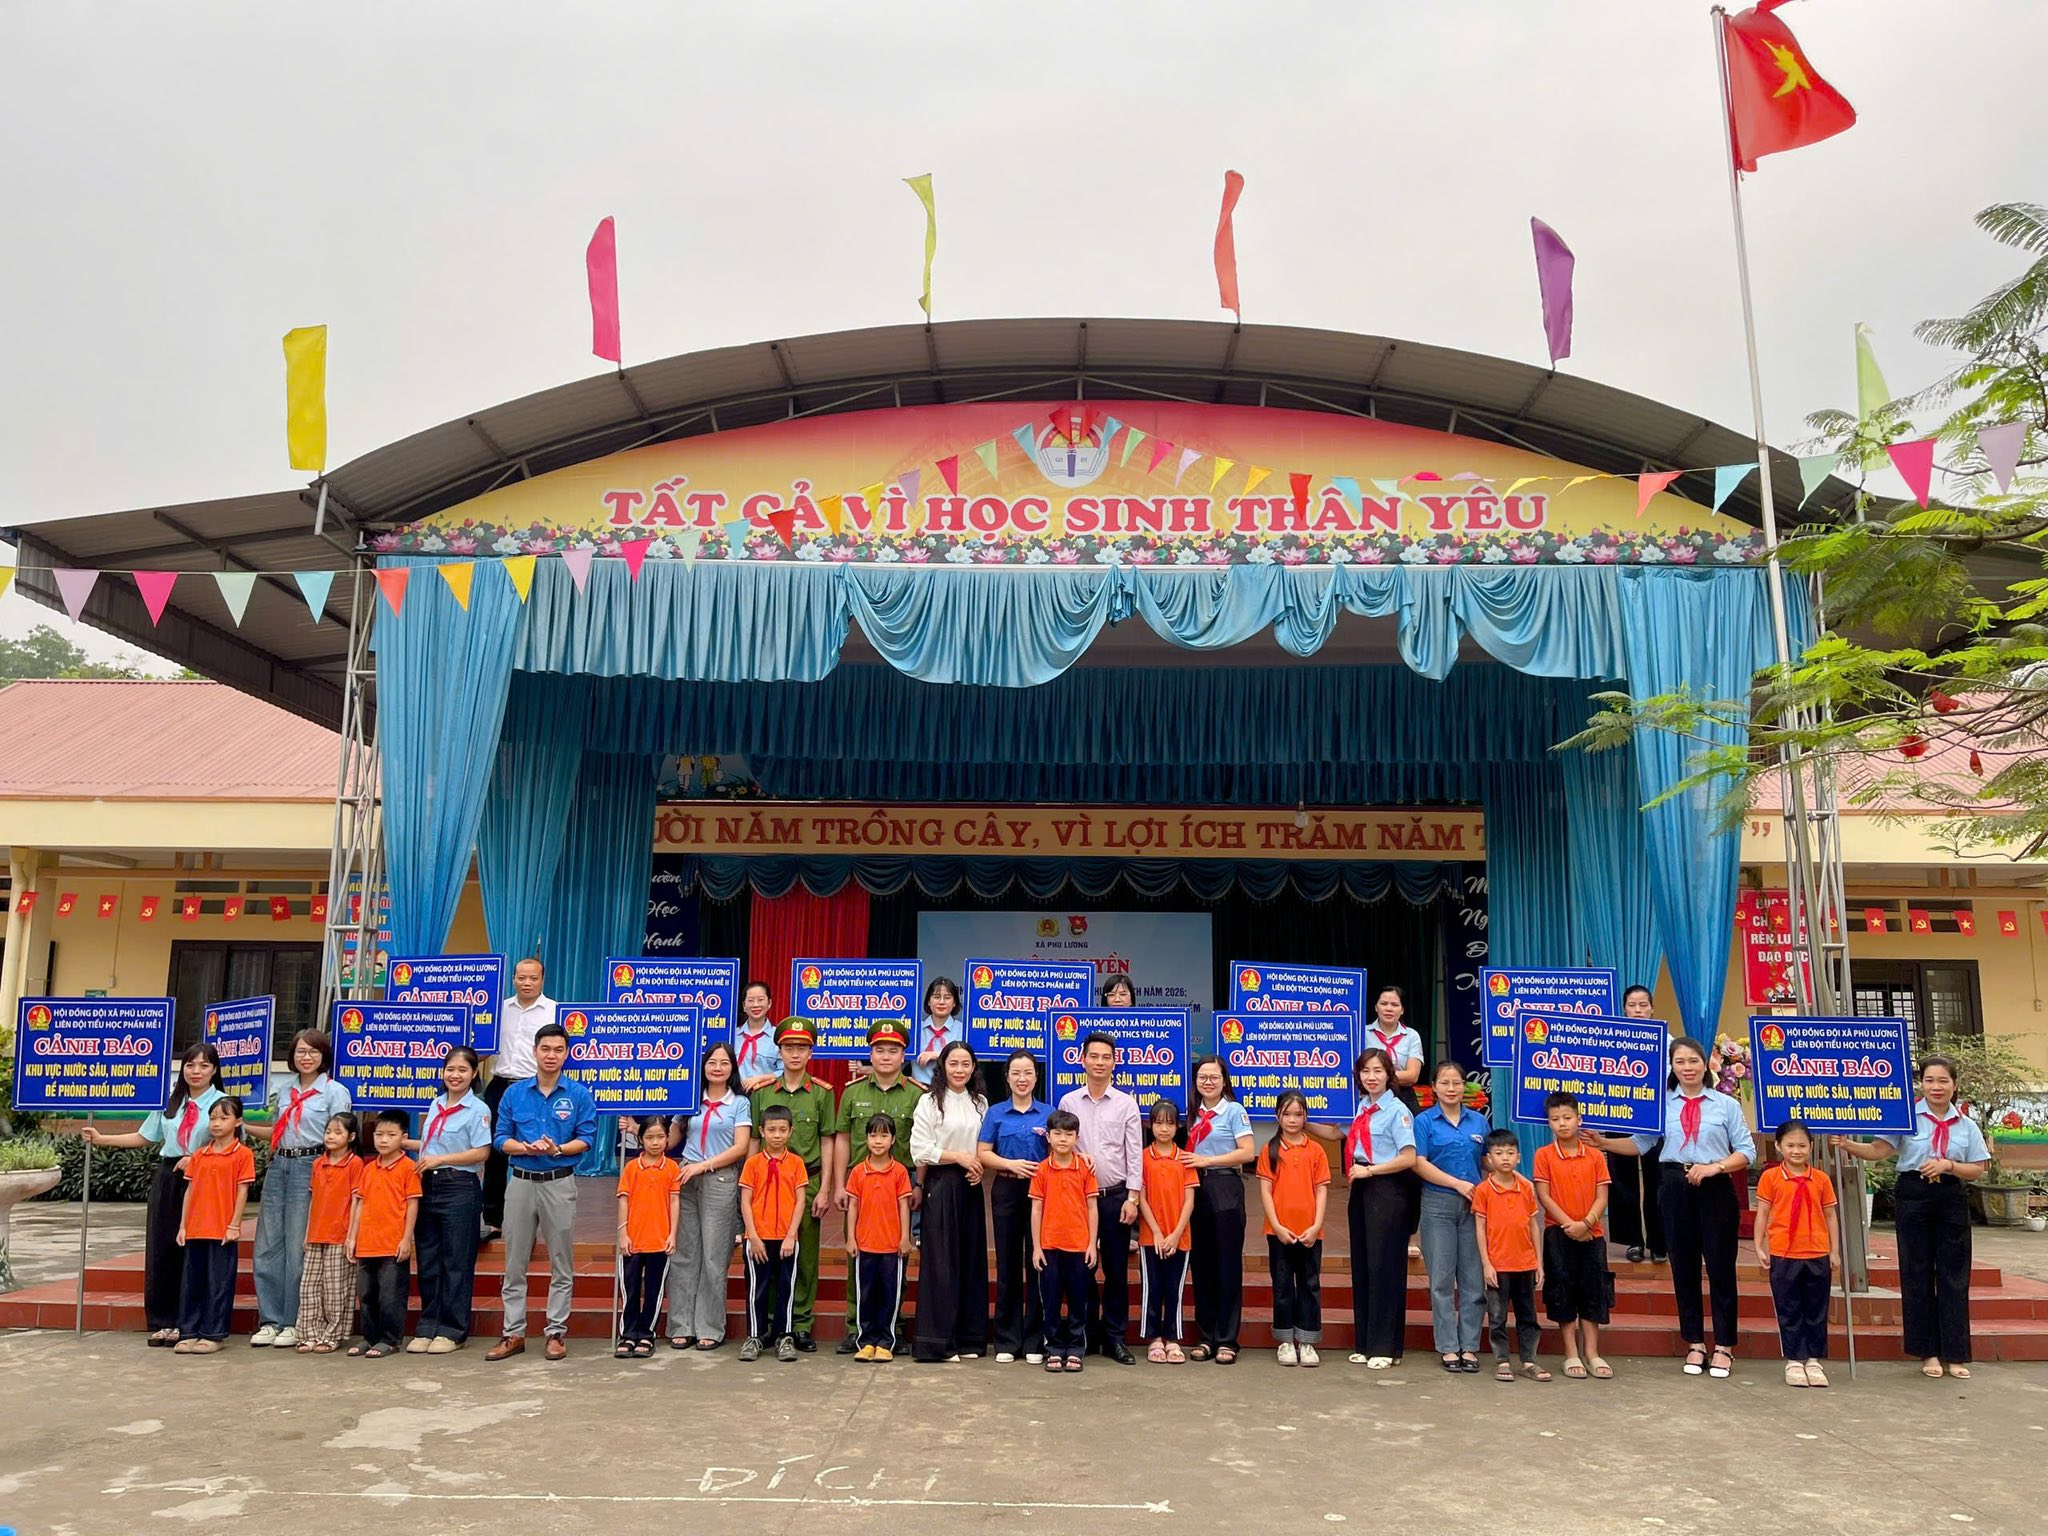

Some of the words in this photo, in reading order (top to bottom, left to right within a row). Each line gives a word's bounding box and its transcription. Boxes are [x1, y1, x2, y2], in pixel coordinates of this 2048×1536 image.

[603, 476, 726, 527] TẤT
[742, 480, 826, 528] CẢ
[842, 486, 908, 531] VÌ
[925, 497, 1048, 542] HỌC
[1065, 497, 1211, 532] SINH
[1227, 486, 1402, 532] THÂN
[1418, 485, 1547, 530] YÊU
[715, 811, 803, 845] NĂM
[811, 808, 945, 846] TRỒNG
[953, 811, 1040, 849] CÂY,
[1051, 813, 1093, 847] VÌ
[1104, 817, 1168, 855] LỢI
[1179, 813, 1247, 849] ÍCH
[1256, 815, 1367, 850] TRĂM
[1376, 816, 1466, 851] NĂM
[1785, 951, 1808, 962] ĐC
[878, 969, 891, 977] PHÚ
[824, 979, 837, 987] LIÊN
[838, 980, 849, 988] ĐỘI
[850, 978, 864, 987] TIỂU
[865, 980, 878, 988] HỌC
[900, 979, 913, 987] TIÊN
[1144, 986, 1163, 996] NĂM
[1165, 987, 1187, 997] 2026;
[398, 987, 449, 1002] CẢNH
[451, 987, 488, 1005] BÁO
[807, 990, 862, 1010] CẢNH
[866, 992, 906, 1010] BÁO
[979, 991, 1034, 1011] CẢNH
[1246, 994, 1303, 1011] CẢNH
[54, 1008, 67, 1017] HỘI
[93, 1009, 106, 1018] ĐỘI
[119, 1008, 136, 1017] PHÚ
[137, 1009, 163, 1017] LƯƠNG
[595, 1014, 606, 1023] HỘI
[628, 1014, 640, 1023] ĐỘI
[651, 1014, 664, 1022] PHÚ
[666, 1014, 688, 1022] LƯƠNG
[55, 1020, 71, 1028] LIÊN
[72, 1020, 86, 1030] ĐỘI
[88, 1018, 105, 1028] TIỂU
[106, 1021, 122, 1030] HỌC
[592, 1025, 606, 1034] LIÊN
[607, 1026, 619, 1034] ĐỘI
[663, 1026, 672, 1034] TỰ
[1551, 1024, 1564, 1032] HỘI
[1589, 1026, 1602, 1035] ĐỘI
[1615, 1028, 1630, 1037] PHÚ
[1632, 1030, 1658, 1040] LƯƠNG
[1787, 1029, 1801, 1037] HỘI
[1827, 1029, 1841, 1037] ĐỘI
[1854, 1029, 1870, 1037] PHÚ
[34, 1033, 99, 1055] CẢNH
[103, 1035, 152, 1055] BÁO
[347, 1035, 405, 1058] CẢNH
[409, 1038, 452, 1058] BÁO
[571, 1039, 633, 1060] CẢNH
[637, 1039, 683, 1060] BÁO
[1550, 1034, 1566, 1043] LIÊN
[1567, 1036, 1580, 1046] ĐỘI
[1582, 1035, 1597, 1045] TIỂU
[1599, 1040, 1615, 1049] HỌC
[1616, 1041, 1638, 1051] ĐỘNG
[1640, 1044, 1655, 1052] ĐẠT
[1792, 1040, 1809, 1048] LIÊN
[1810, 1041, 1824, 1051] ĐỘI
[1825, 1039, 1842, 1049] TIỂU
[1843, 1042, 1859, 1051] HỌC
[1860, 1040, 1876, 1049] YÊN
[1877, 1042, 1891, 1051] LẠC
[1128, 1045, 1173, 1066] BÁO
[1230, 1045, 1290, 1067] CẢNH
[1295, 1047, 1340, 1068] BÁO
[1532, 1048, 1597, 1074] CẢNH
[1601, 1053, 1648, 1078] BÁO
[26, 1064, 42, 1076] KHU
[46, 1064, 61, 1079] VỰC
[64, 1062, 86, 1076] NƯỚC
[89, 1062, 108, 1078] SÂU,
[111, 1065, 134, 1076] NGUY
[136, 1060, 158, 1077] HIỂM
[1772, 1053, 1838, 1077] CẢNH
[1843, 1056, 1892, 1077] BÁO
[582, 1069, 597, 1085] VỰC
[599, 1067, 622, 1082] NƯỚC
[624, 1067, 642, 1082] SÂU,
[645, 1069, 666, 1081] NGUY
[668, 1064, 688, 1081] HIỂM
[1242, 1075, 1256, 1090] VỰC
[1259, 1074, 1280, 1088] NƯỚC
[1283, 1075, 1301, 1090] SÂU,
[1303, 1077, 1325, 1088] NGUY
[1327, 1072, 1347, 1089] HIỂM
[58, 1082, 87, 1097] PHÒNG
[89, 1081, 109, 1097] ĐUỐI
[112, 1083, 135, 1097] NƯỚC
[595, 1088, 622, 1101] PHÒNG
[625, 1087, 643, 1101] ĐUỐI
[646, 1086, 667, 1101] NƯỚC
[1524, 1077, 1542, 1090] KHU
[1544, 1078, 1559, 1094] VỰC
[1562, 1080, 1584, 1094] NƯỚC
[1587, 1083, 1606, 1098] SÂU,
[1609, 1086, 1631, 1099] NGUY
[1633, 1083, 1655, 1100] HIỂM
[1767, 1085, 1784, 1097] KHU
[1788, 1084, 1803, 1100] VỰC
[1806, 1084, 1829, 1098] NƯỚC
[1832, 1084, 1852, 1100] SÂU,
[1854, 1087, 1877, 1099] NGUY
[1879, 1082, 1901, 1099] HIỂM
[1588, 1101, 1608, 1116] ĐUỐI
[1610, 1104, 1633, 1119] NƯỚC
[1804, 1104, 1833, 1119] PHÒNG
[1836, 1104, 1856, 1120] ĐUỐI
[1858, 1106, 1882, 1120] NƯỚC
